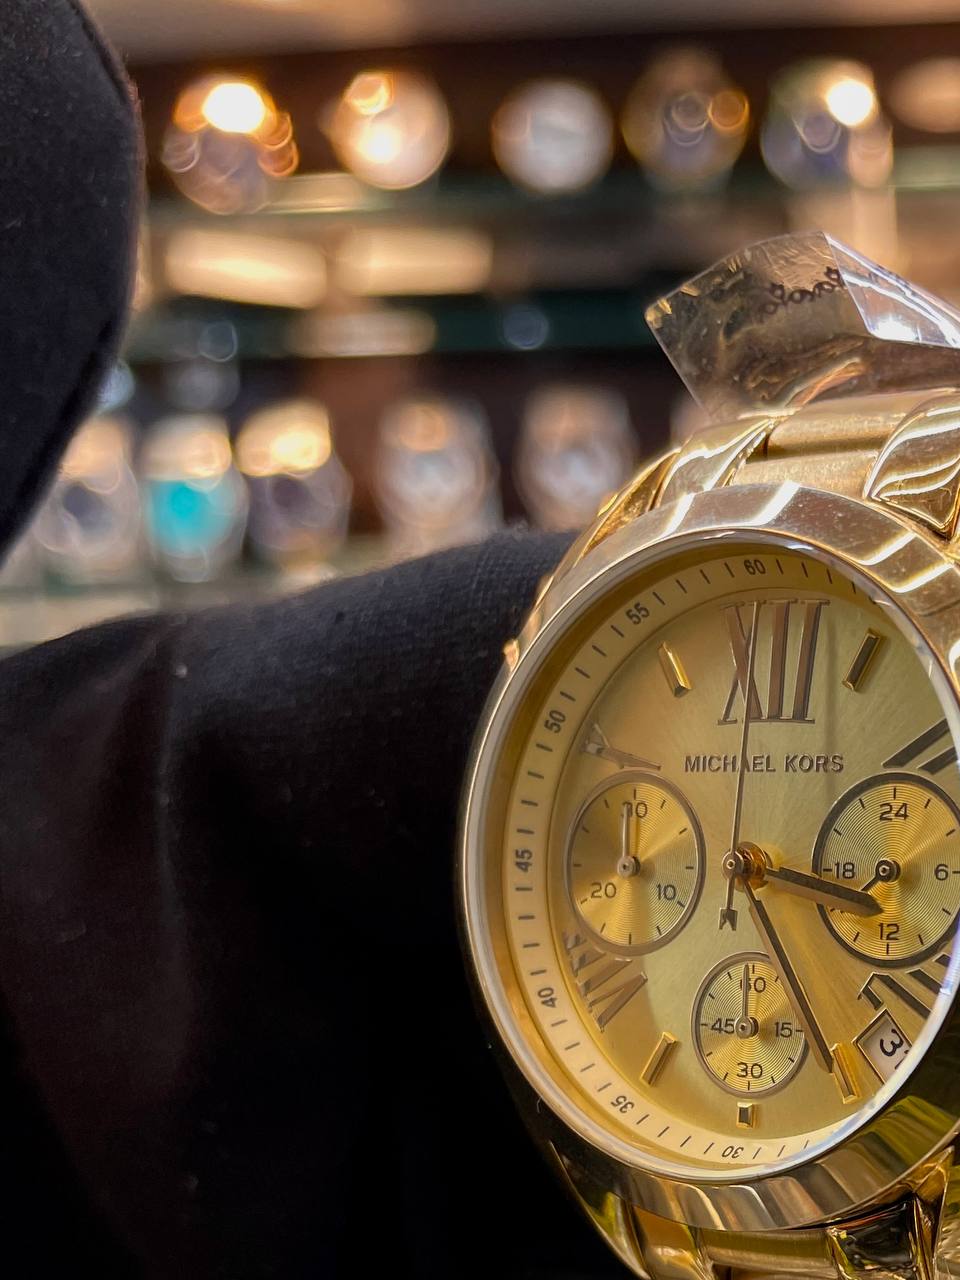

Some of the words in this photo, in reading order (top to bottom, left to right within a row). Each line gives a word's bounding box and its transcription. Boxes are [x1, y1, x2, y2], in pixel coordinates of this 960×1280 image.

[743, 558, 767, 576] 60
[626, 602, 651, 626] 55
[716, 600, 831, 726] XII
[544, 709, 567, 735] 50
[684, 754, 776, 774] MICHAEL
[783, 754, 844, 774] KORS
[879, 802, 910, 821] 24
[515, 848, 532, 873] 45
[834, 863, 856, 880] 18
[934, 863, 949, 881] 6
[589, 883, 617, 900] 20
[656, 884, 677, 900] 10
[878, 922, 901, 941] 12
[537, 985, 558, 1010] 40
[711, 1018, 735, 1036] 45
[773, 1020, 794, 1038] 15
[736, 1062, 763, 1080] 30
[611, 1093, 635, 1117] 35
[721, 1144, 744, 1159] 30
